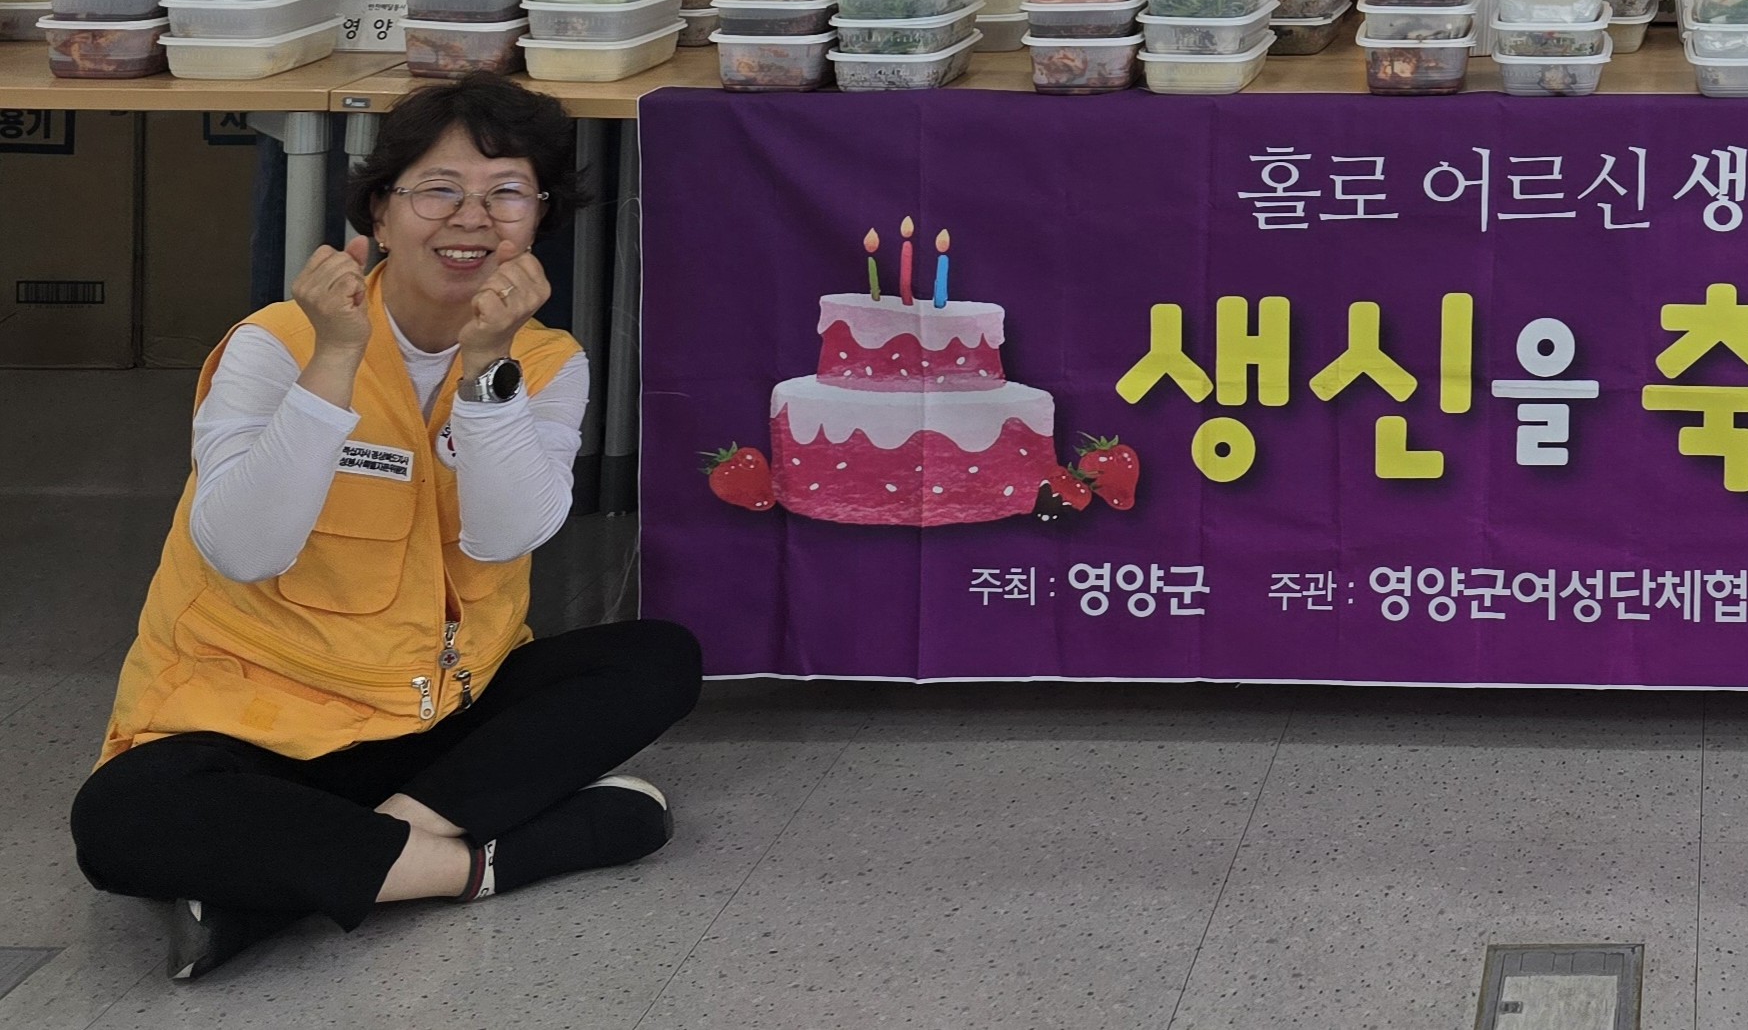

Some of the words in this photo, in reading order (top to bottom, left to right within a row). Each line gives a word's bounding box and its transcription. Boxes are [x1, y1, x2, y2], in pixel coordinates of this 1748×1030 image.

[1238, 147, 1398, 229] 홀로
[1424, 147, 1650, 232] 어르신
[1115, 291, 1600, 483] 생신을
[969, 567, 1035, 605] 주최
[1068, 563, 1210, 617] 영양군
[1268, 571, 1337, 610] 주관
